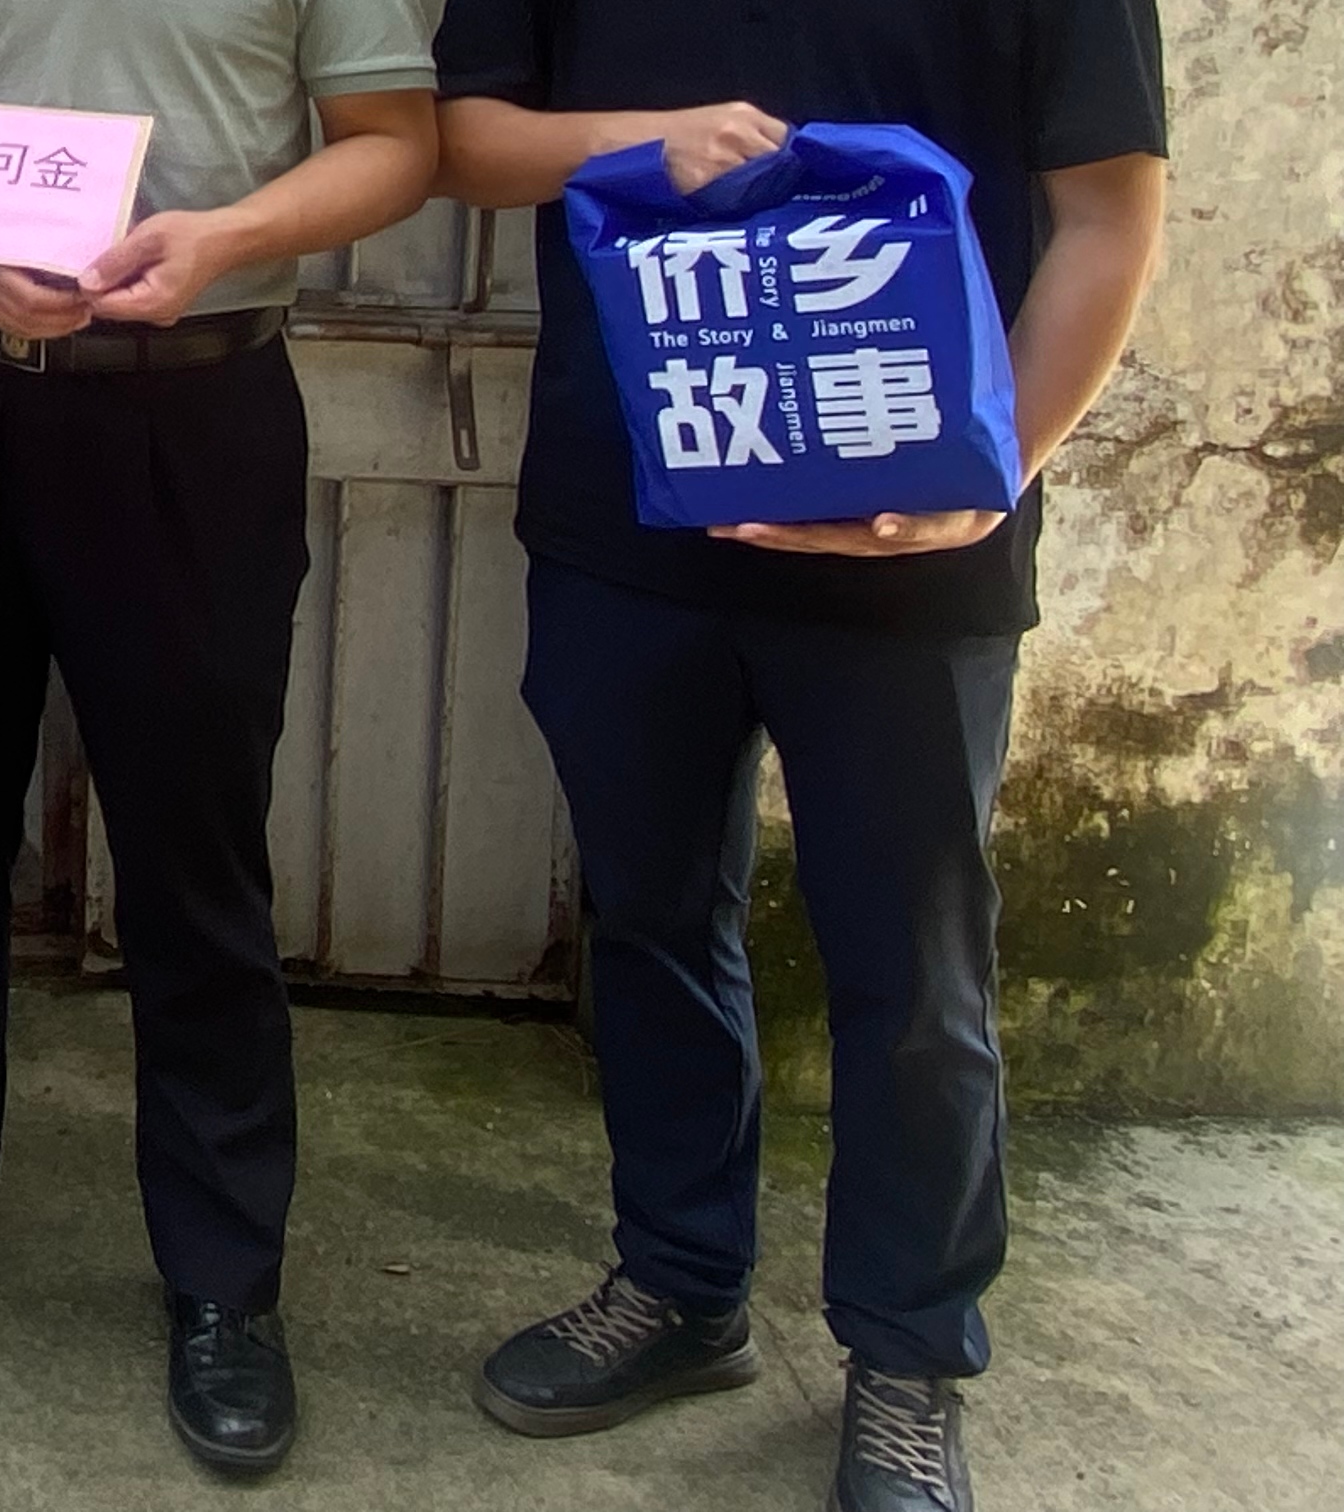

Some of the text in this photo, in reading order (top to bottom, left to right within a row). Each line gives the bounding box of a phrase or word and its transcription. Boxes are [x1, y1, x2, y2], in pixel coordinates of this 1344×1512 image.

[759, 256, 780, 307] Story
[649, 316, 916, 348] The Story & Jiangmen
[648, 347, 942, 469] 故事
[775, 362, 807, 455] Jiangmen
